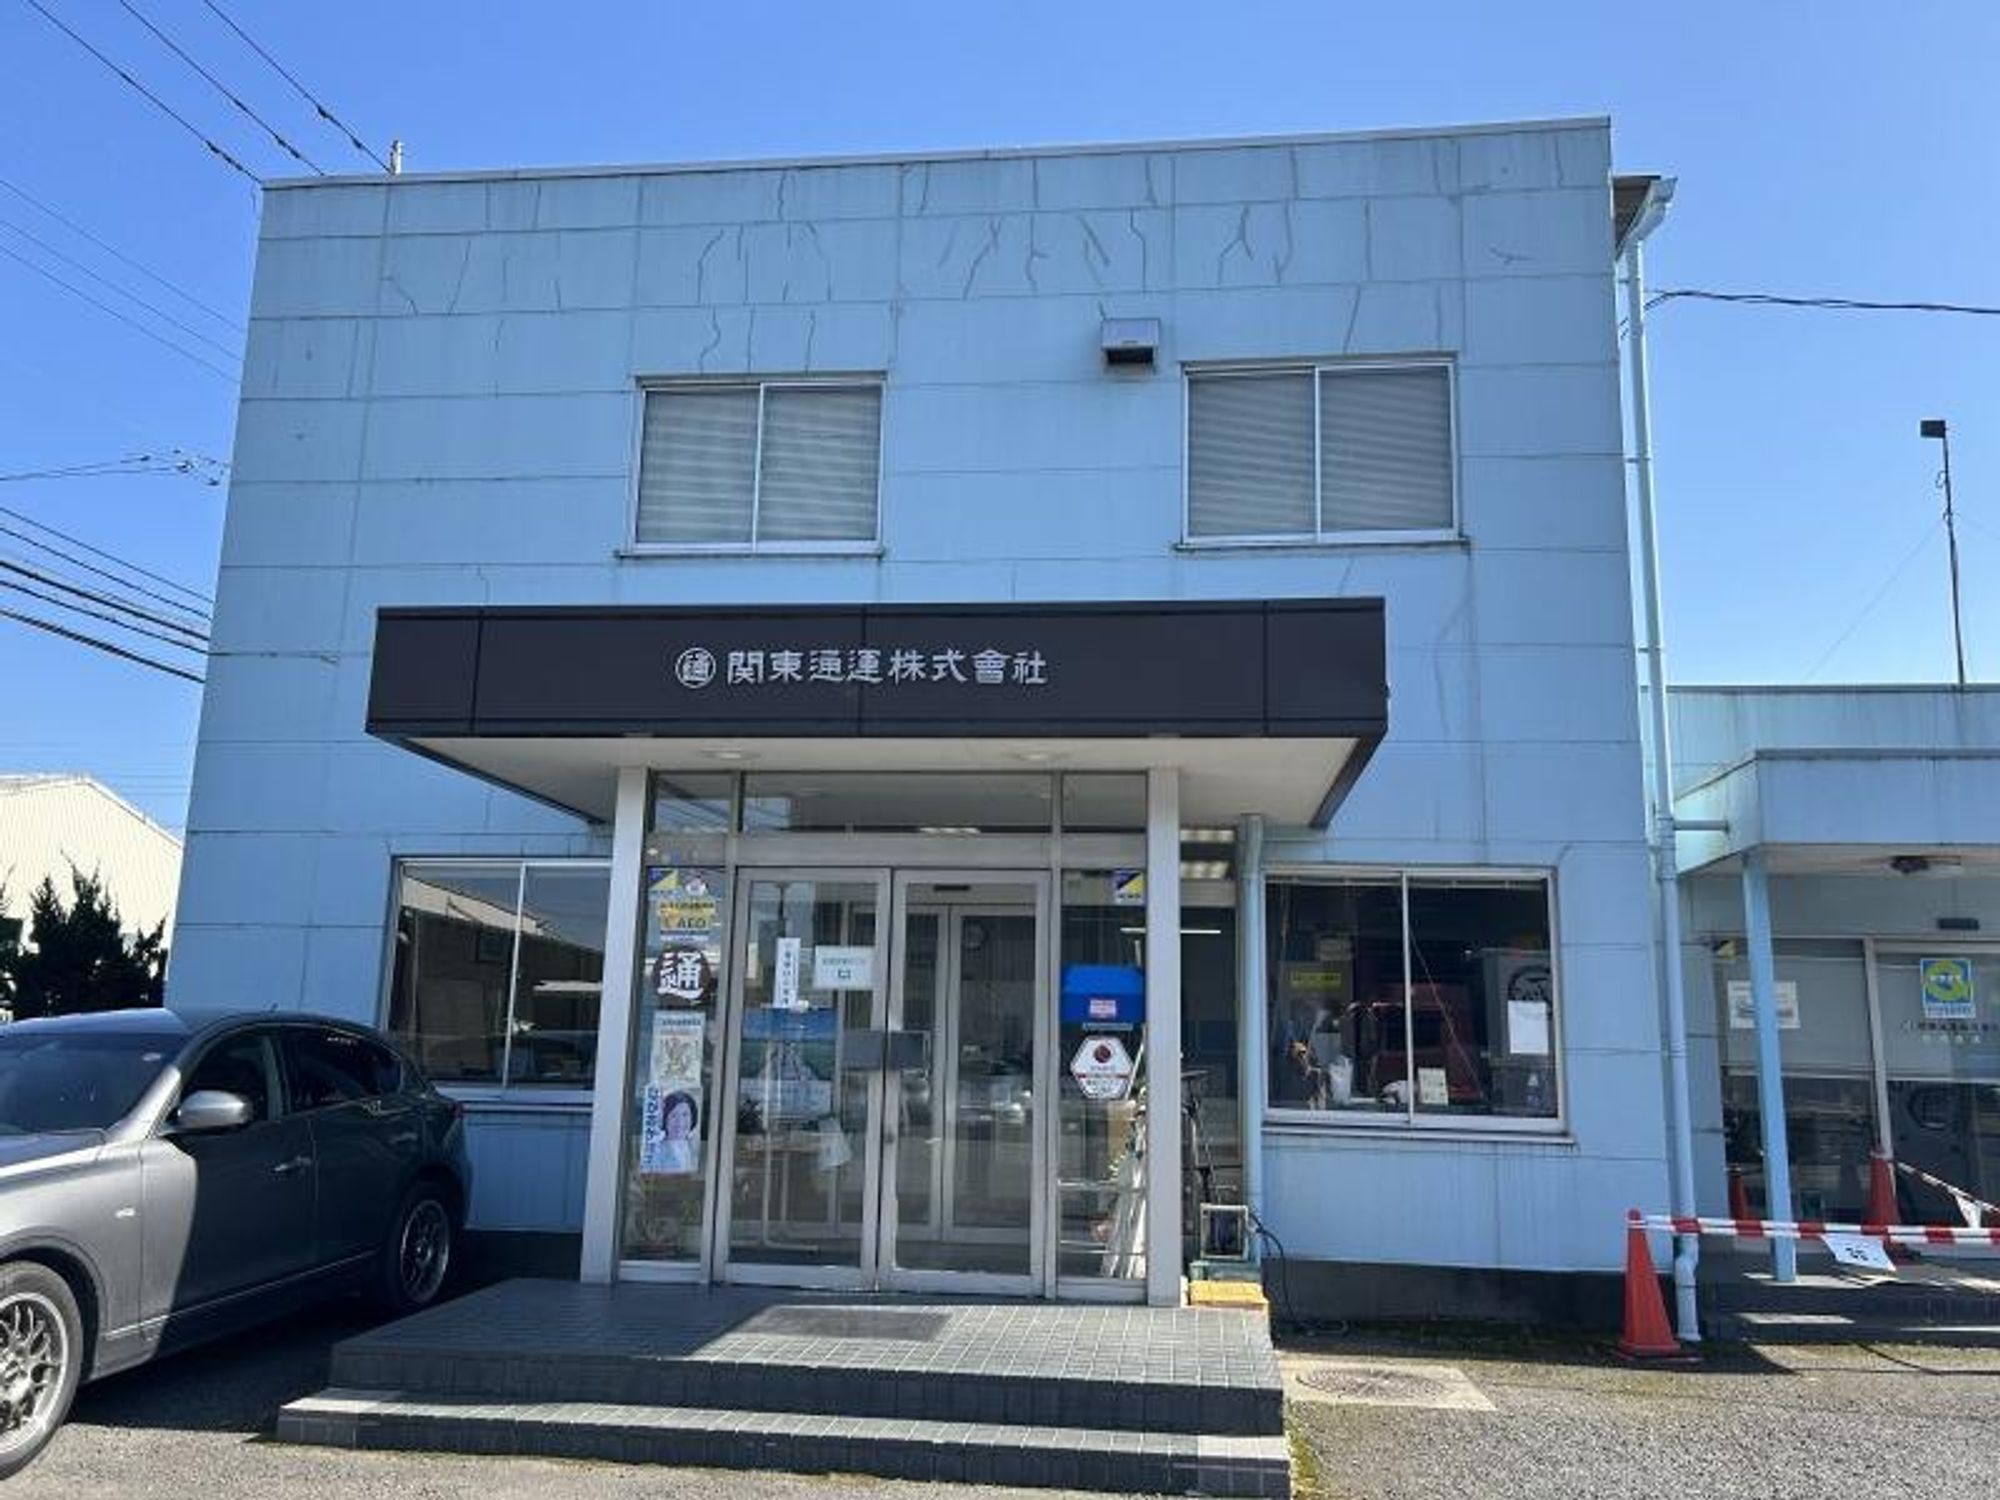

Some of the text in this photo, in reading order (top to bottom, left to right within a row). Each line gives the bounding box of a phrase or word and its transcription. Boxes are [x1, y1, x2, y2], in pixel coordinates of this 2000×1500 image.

[726, 649, 1048, 685] 関東通運株式會社
[657, 951, 704, 999] 通
